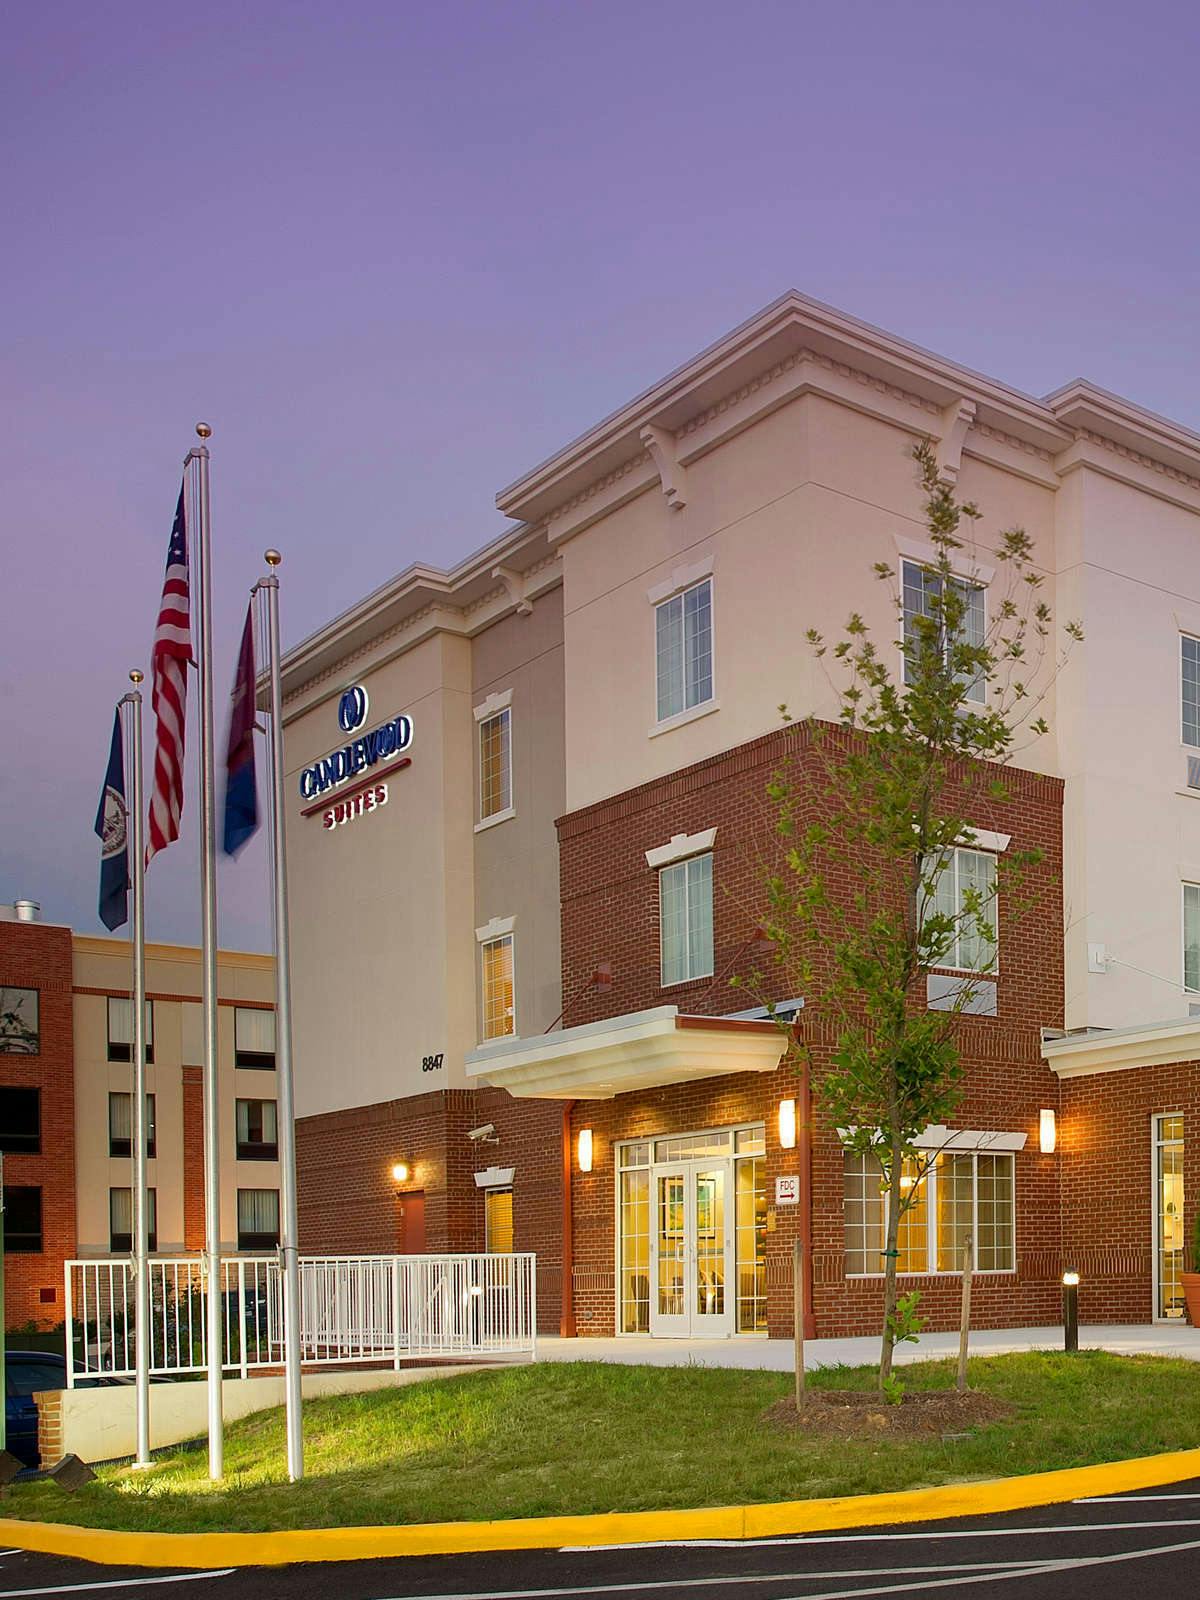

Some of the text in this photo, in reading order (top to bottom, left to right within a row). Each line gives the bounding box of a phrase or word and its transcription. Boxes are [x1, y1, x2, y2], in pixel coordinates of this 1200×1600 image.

[300, 715, 413, 800] CANDLEWOOD
[323, 784, 388, 829] SUITES
[422, 1053, 444, 1072] 8847
[780, 1180, 795, 1190] FDC
